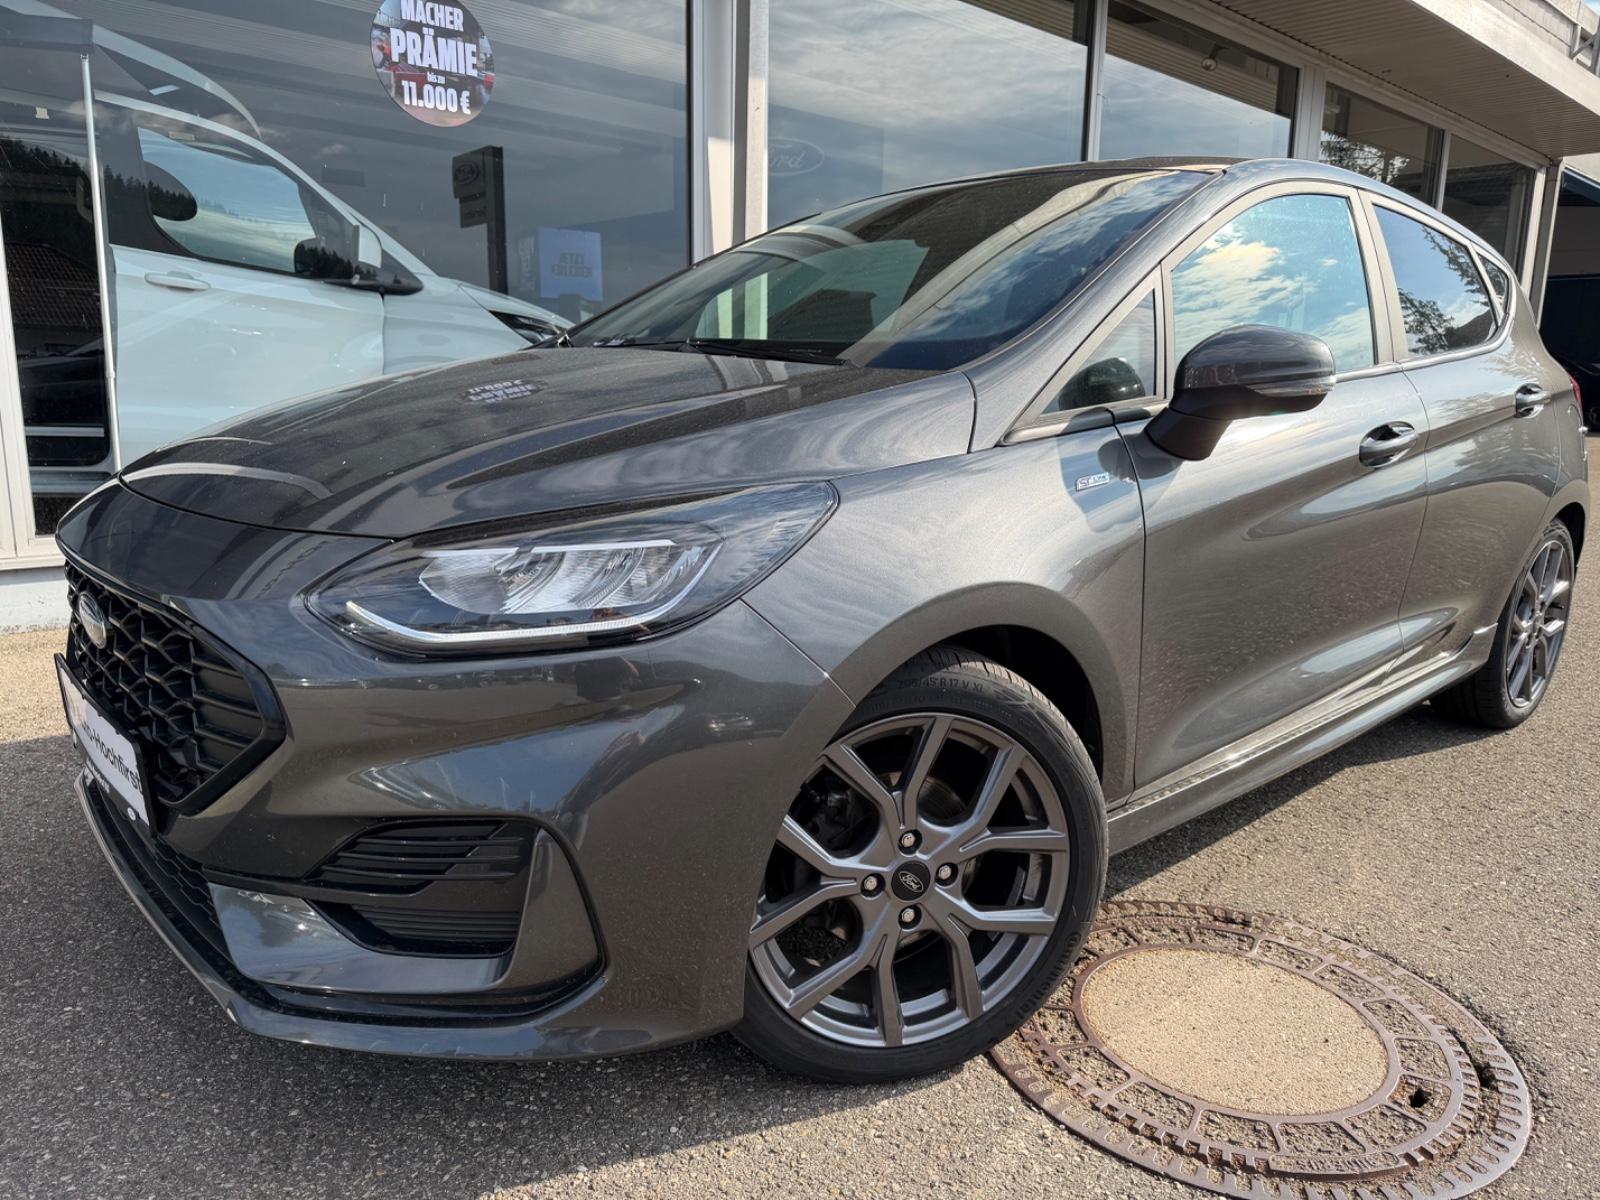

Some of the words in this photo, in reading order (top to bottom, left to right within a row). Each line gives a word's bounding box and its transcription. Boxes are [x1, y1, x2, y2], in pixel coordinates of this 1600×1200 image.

[400, 0, 464, 32] MACHER
[390, 27, 478, 77] PRÄMIE
[401, 80, 457, 112] 11.000
[460, 90, 471, 114] €
